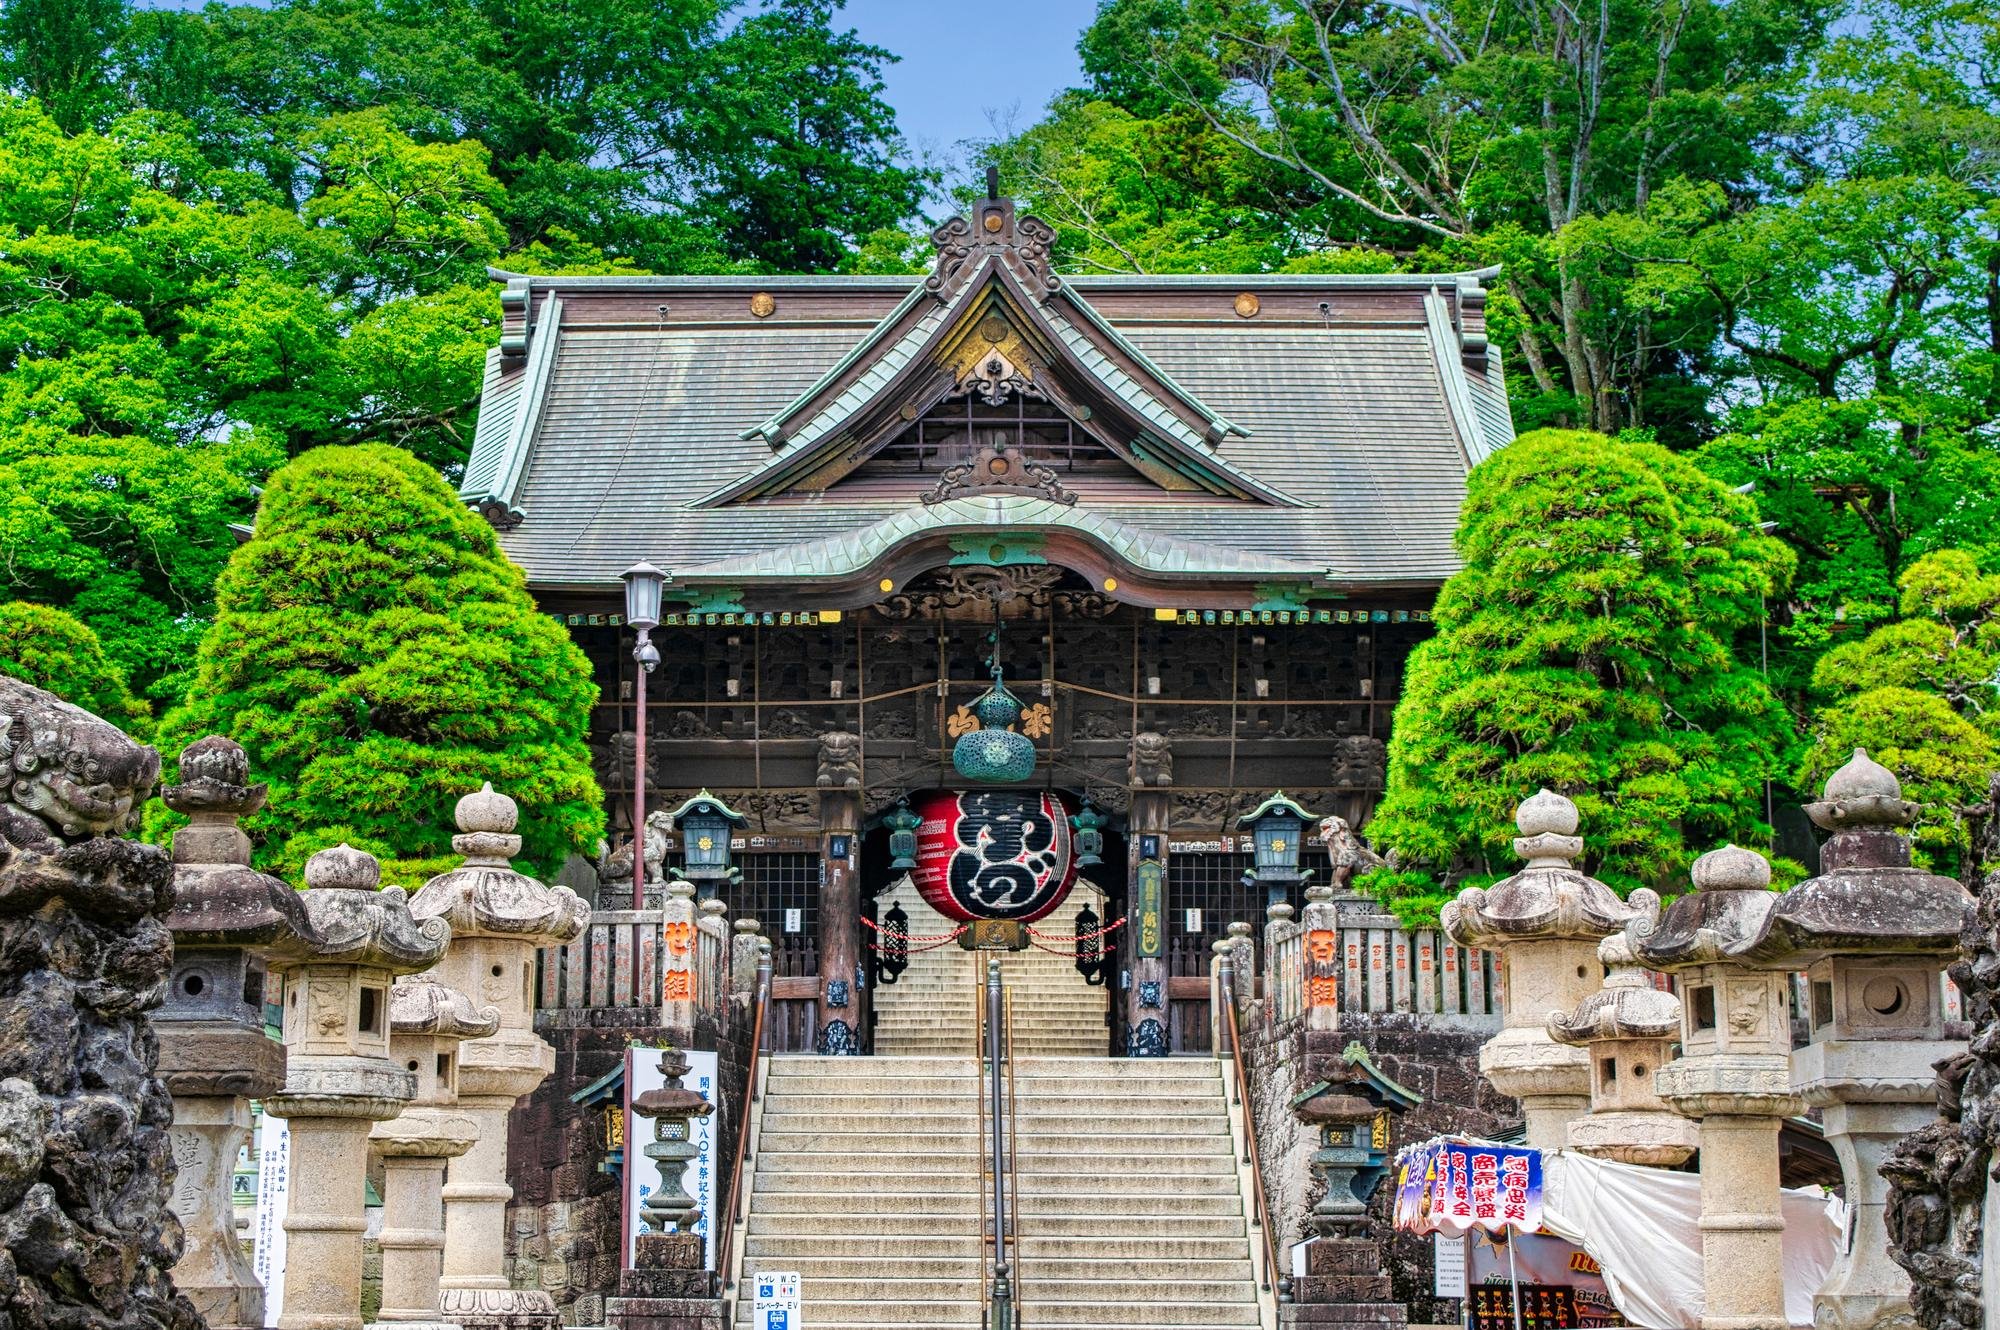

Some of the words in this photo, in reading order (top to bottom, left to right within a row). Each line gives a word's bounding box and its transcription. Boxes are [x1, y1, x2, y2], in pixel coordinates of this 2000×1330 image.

[1451, 1152, 1471, 1217] 家内安全
[1473, 1153, 1498, 1219] 商売繁盛
[758, 1275, 775, 1283] トイレ
